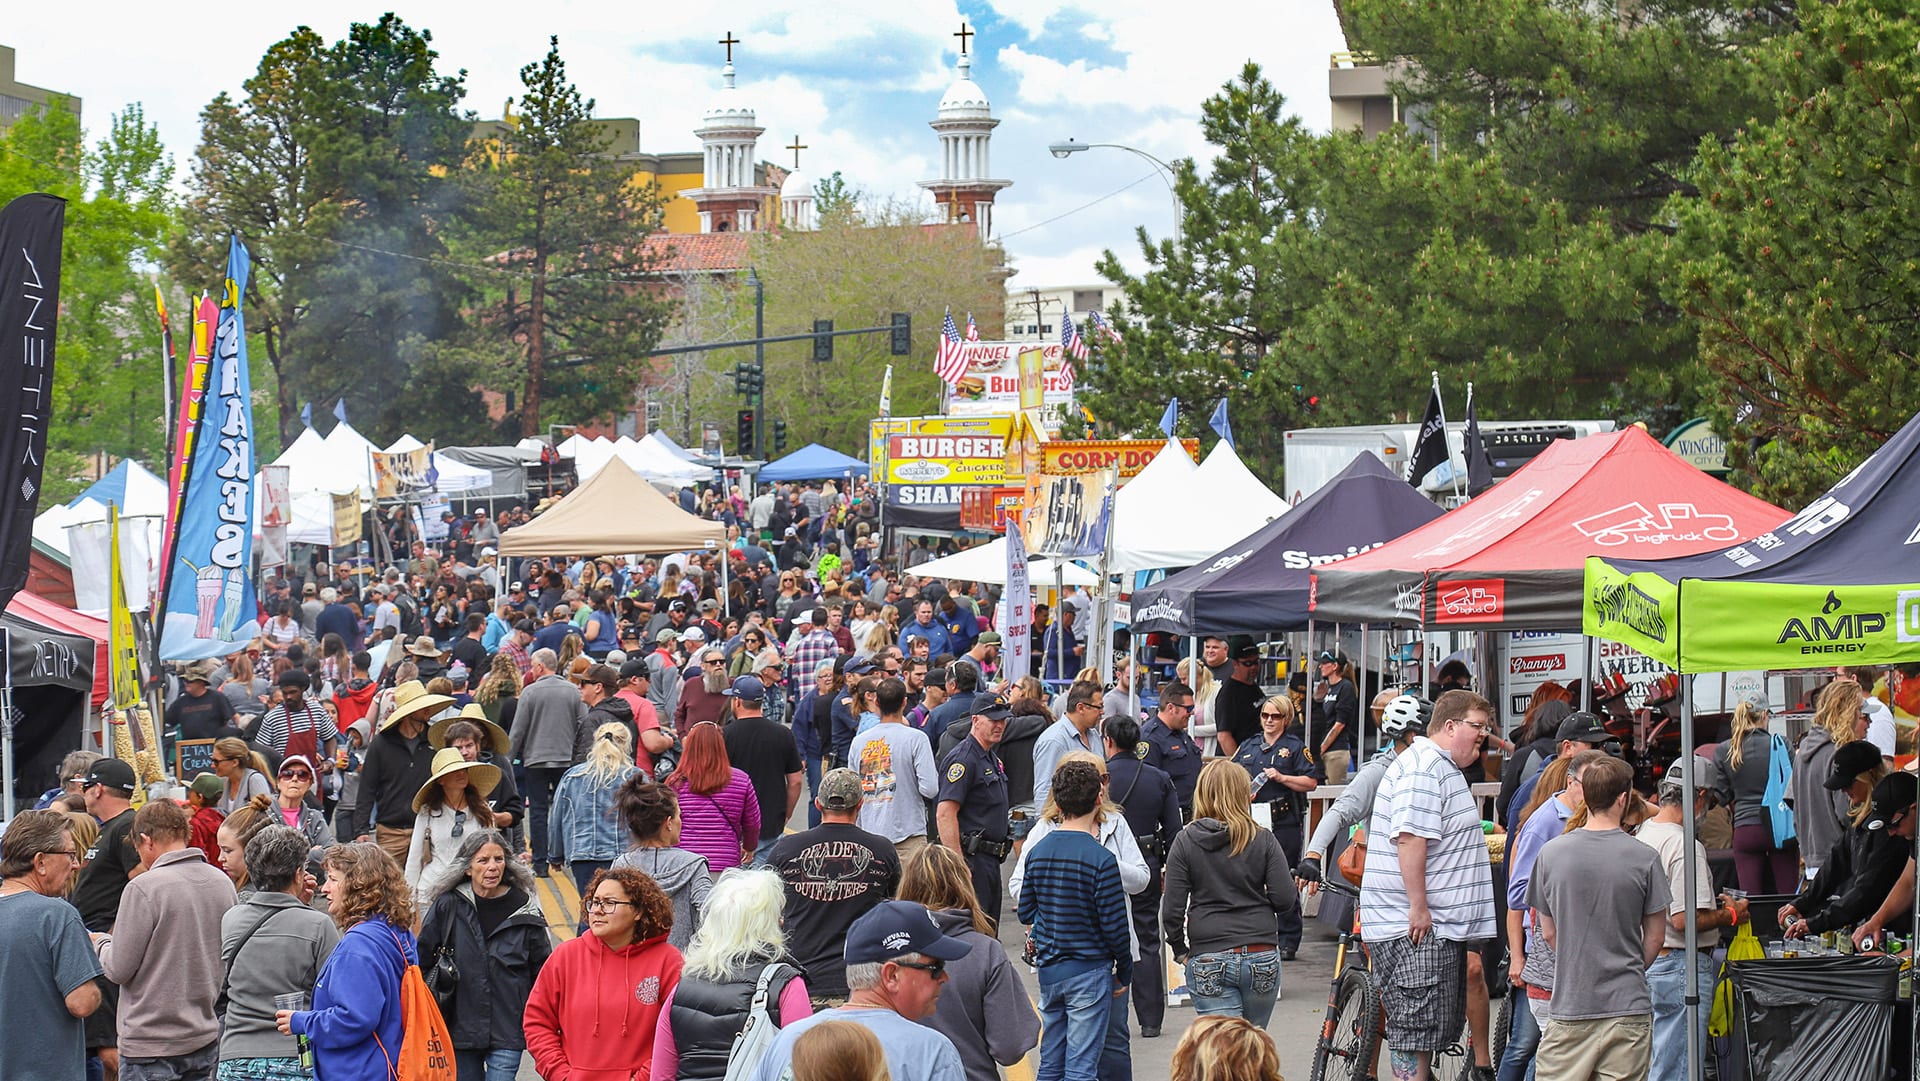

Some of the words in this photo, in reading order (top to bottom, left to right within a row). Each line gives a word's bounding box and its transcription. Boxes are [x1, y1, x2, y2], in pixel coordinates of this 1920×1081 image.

[21, 247, 44, 466] ANETIK
[1058, 451, 1120, 469] CORN
[1694, 456, 1712, 464] CITY
[1633, 533, 1705, 545] bigtruck
[1776, 612, 1887, 644] AMP
[1800, 643, 1868, 655] ENERGY
[1511, 656, 1563, 674] Granny's
[881, 931, 911, 947] NEVADA
